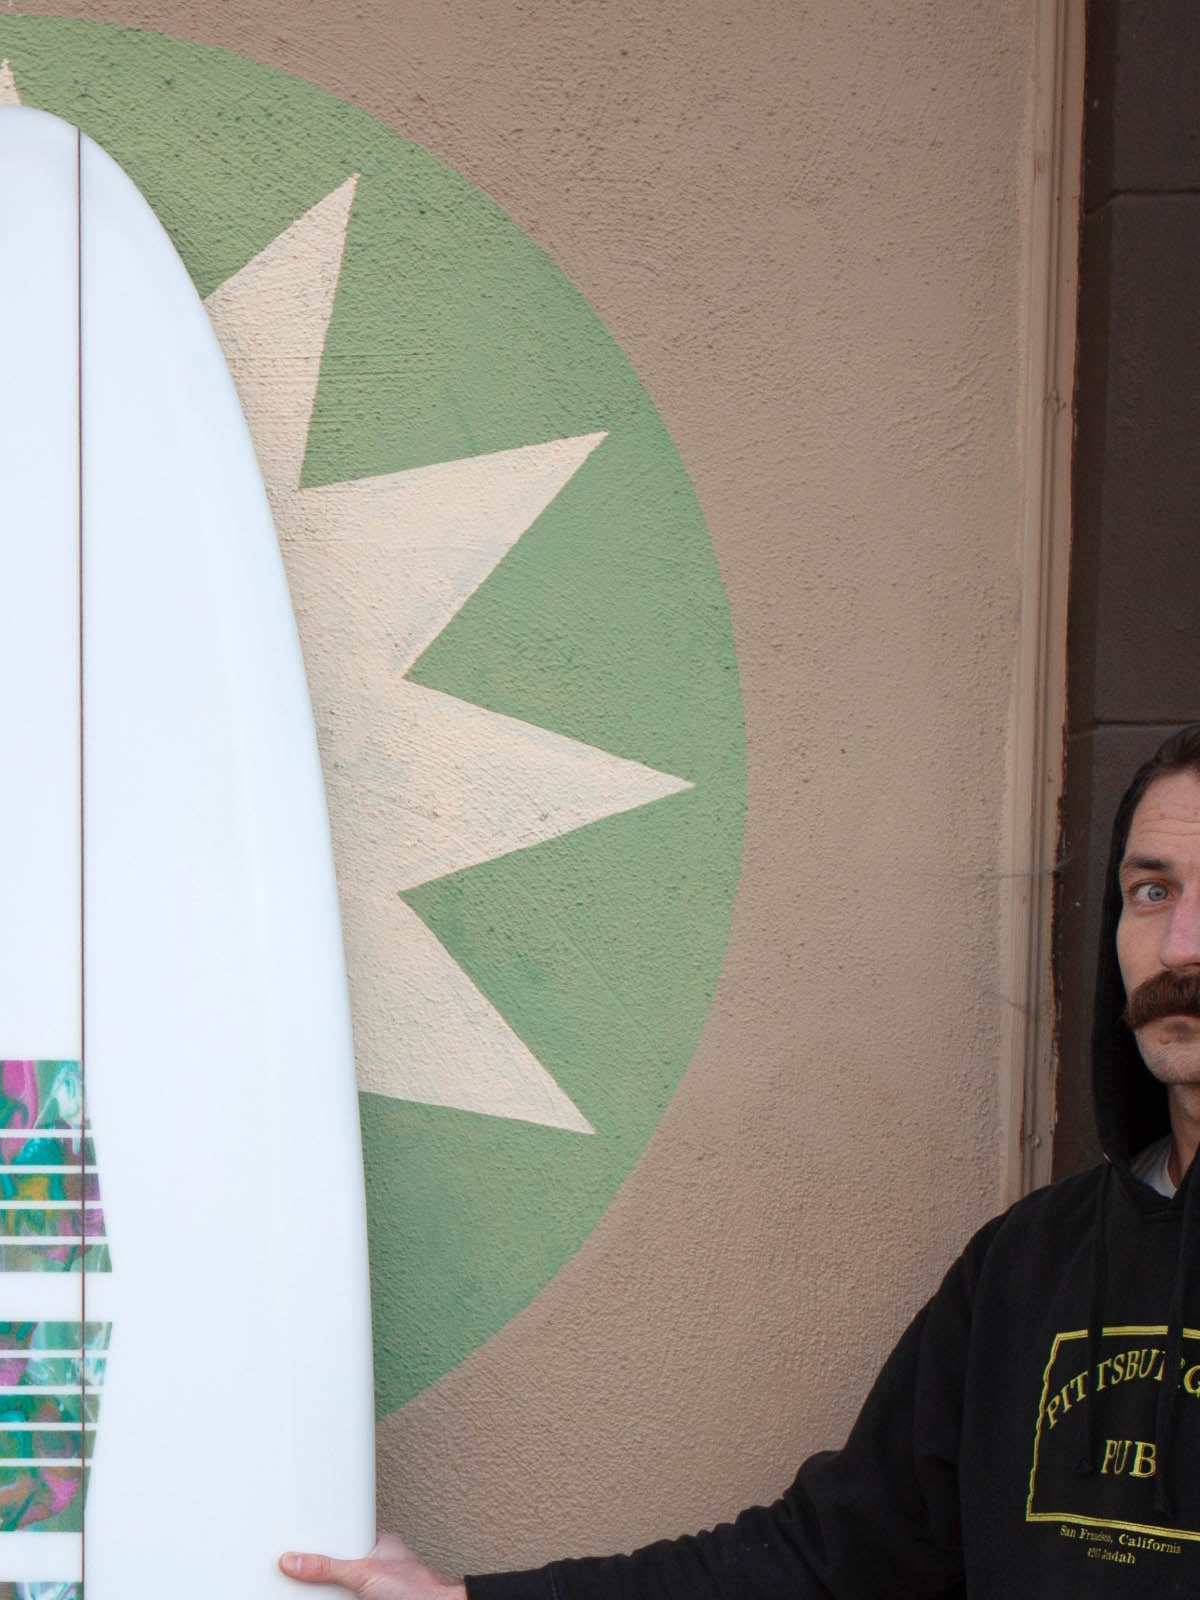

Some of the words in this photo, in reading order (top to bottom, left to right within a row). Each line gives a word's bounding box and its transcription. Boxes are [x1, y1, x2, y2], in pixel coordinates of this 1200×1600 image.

[1100, 1439, 1157, 1478] PUB
[1060, 1525, 1076, 1538] San
[1118, 1533, 1182, 1554] California
